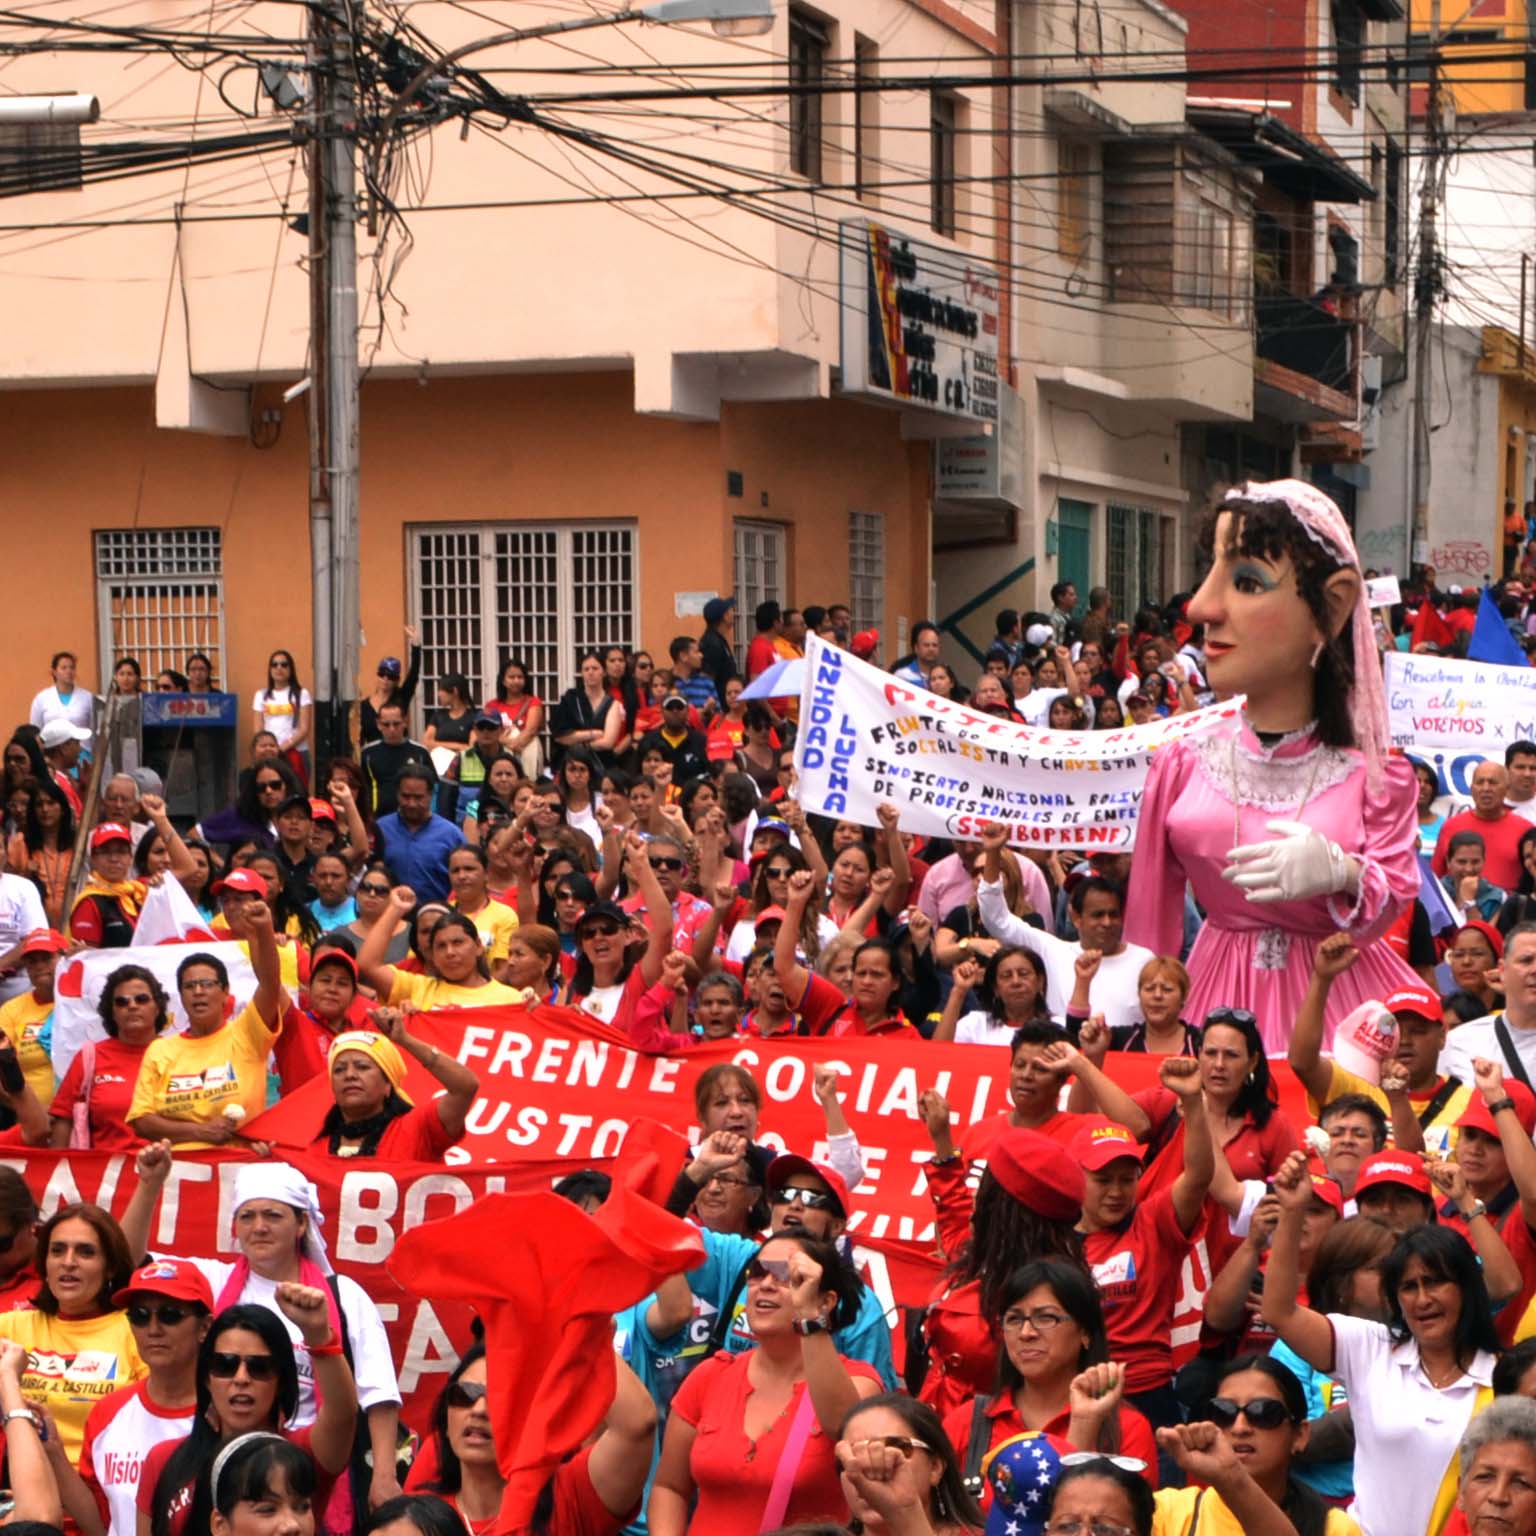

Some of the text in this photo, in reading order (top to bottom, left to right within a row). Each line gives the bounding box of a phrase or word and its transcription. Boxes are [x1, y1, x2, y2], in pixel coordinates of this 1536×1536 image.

[822, 713, 857, 814] LUCHA
[895, 737, 1011, 768] SOCIALISTA
[1017, 753, 1029, 768] Y
[865, 756, 970, 794] SINDICATO
[982, 784, 1076, 806] NACIONAL
[873, 779, 894, 796] DE
[908, 786, 1052, 824] PROFESIONALES
[460, 1025, 685, 1094] FRENTE
